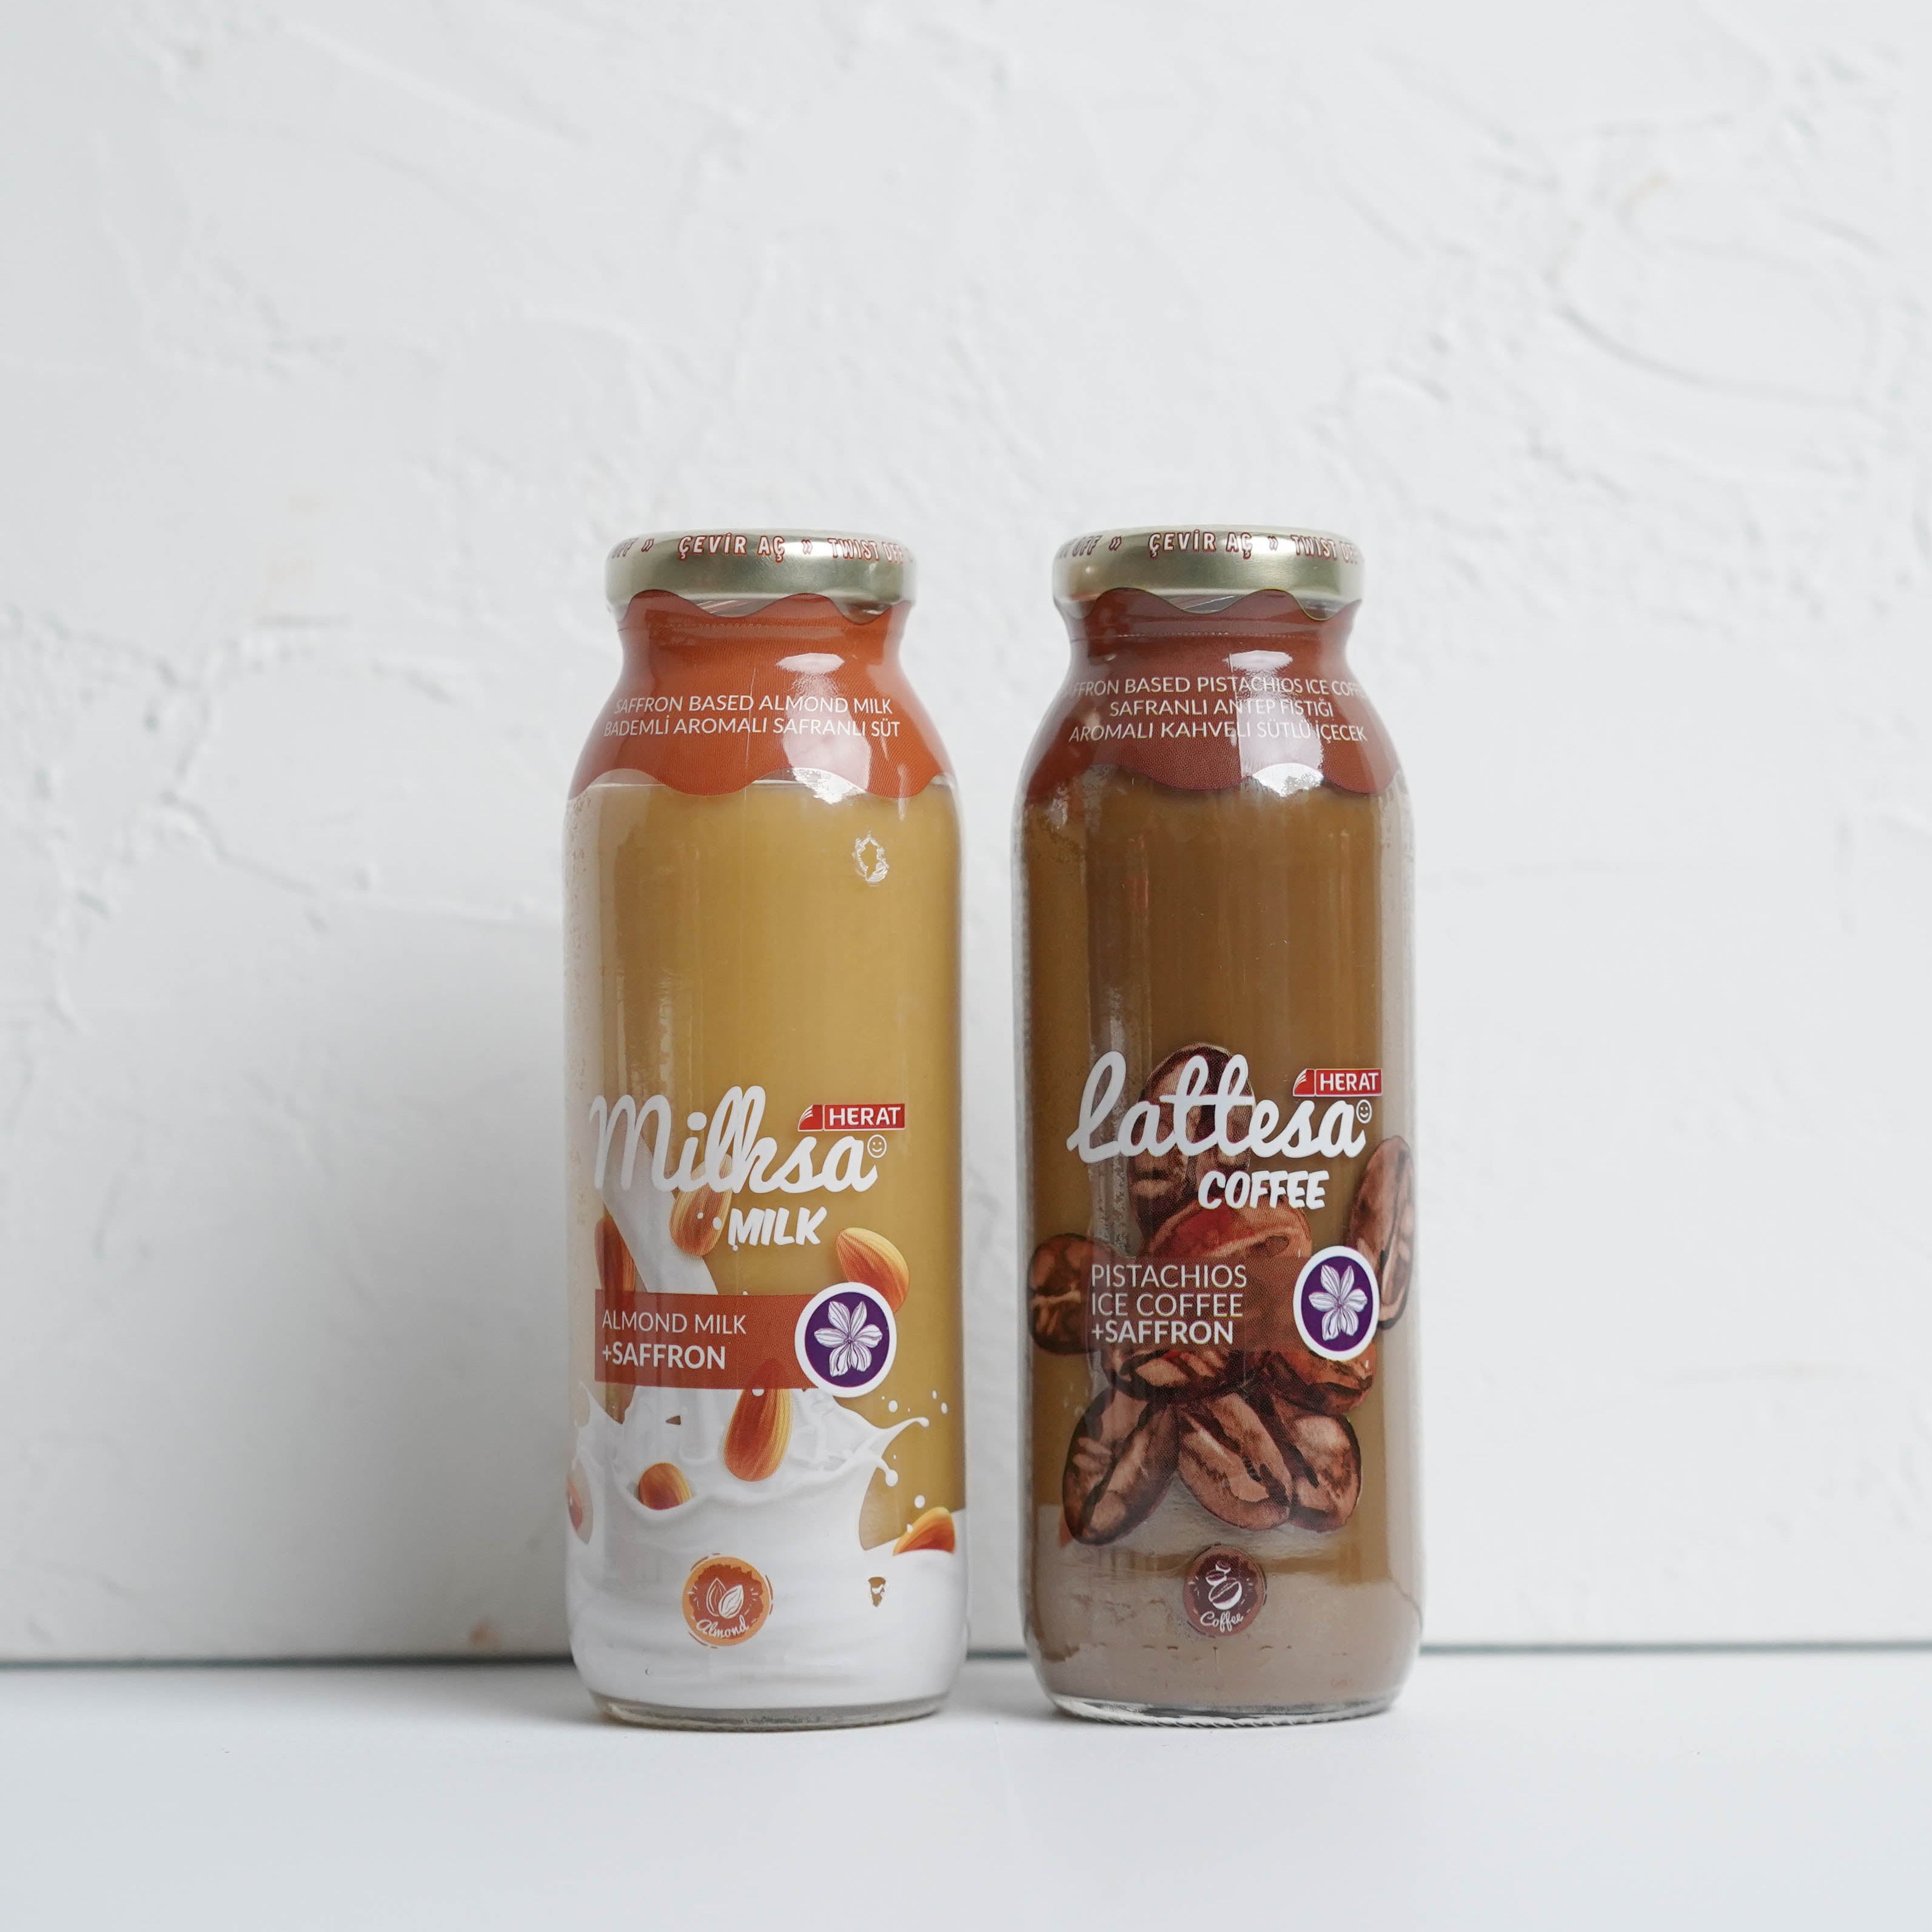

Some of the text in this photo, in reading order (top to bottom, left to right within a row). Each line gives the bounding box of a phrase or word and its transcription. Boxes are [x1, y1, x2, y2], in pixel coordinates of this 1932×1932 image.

[678, 532, 747, 562] ÇEVİR
[757, 535, 785, 563] AÇ
[827, 538, 879, 561] TWIST
[1149, 529, 1216, 558] ÇEVİR
[1226, 532, 1253, 559] AÇ
[1290, 534, 1337, 560] TWIST
[1125, 677, 1189, 694] BASED
[1198, 677, 1303, 694] PISTACHIOS
[1306, 679, 1330, 696] ICE
[614, 694, 893, 714] SAFFRON BASED ALMOND MILK
[1110, 699, 1334, 718] SAFRANLI ANTEP FISTIĞI
[604, 715, 901, 737] BADEMLİ AROMALI SAFRANLI SÜT
[1068, 722, 1153, 742] AROMALI
[1257, 719, 1310, 739] SÜTLÜ
[1315, 720, 1368, 744] İÇECEK
[1320, 1072, 1380, 1092] HERAT
[829, 1106, 902, 1127] HERAT
[589, 1085, 879, 1194] Milksa
[1198, 1170, 1330, 1210] COFFEE
[728, 1206, 828, 1246] MILK
[1092, 1264, 1247, 1289] PISTACHIOS
[1092, 1293, 1244, 1318] ICE COFFEE
[602, 1310, 748, 1335] ALMOND MILK
[1092, 1320, 1234, 1345] +SAFFRON
[602, 1341, 726, 1370] +SAFFRON
[697, 1615, 750, 1638] Almond
[1200, 1611, 1244, 1632] Coffee
